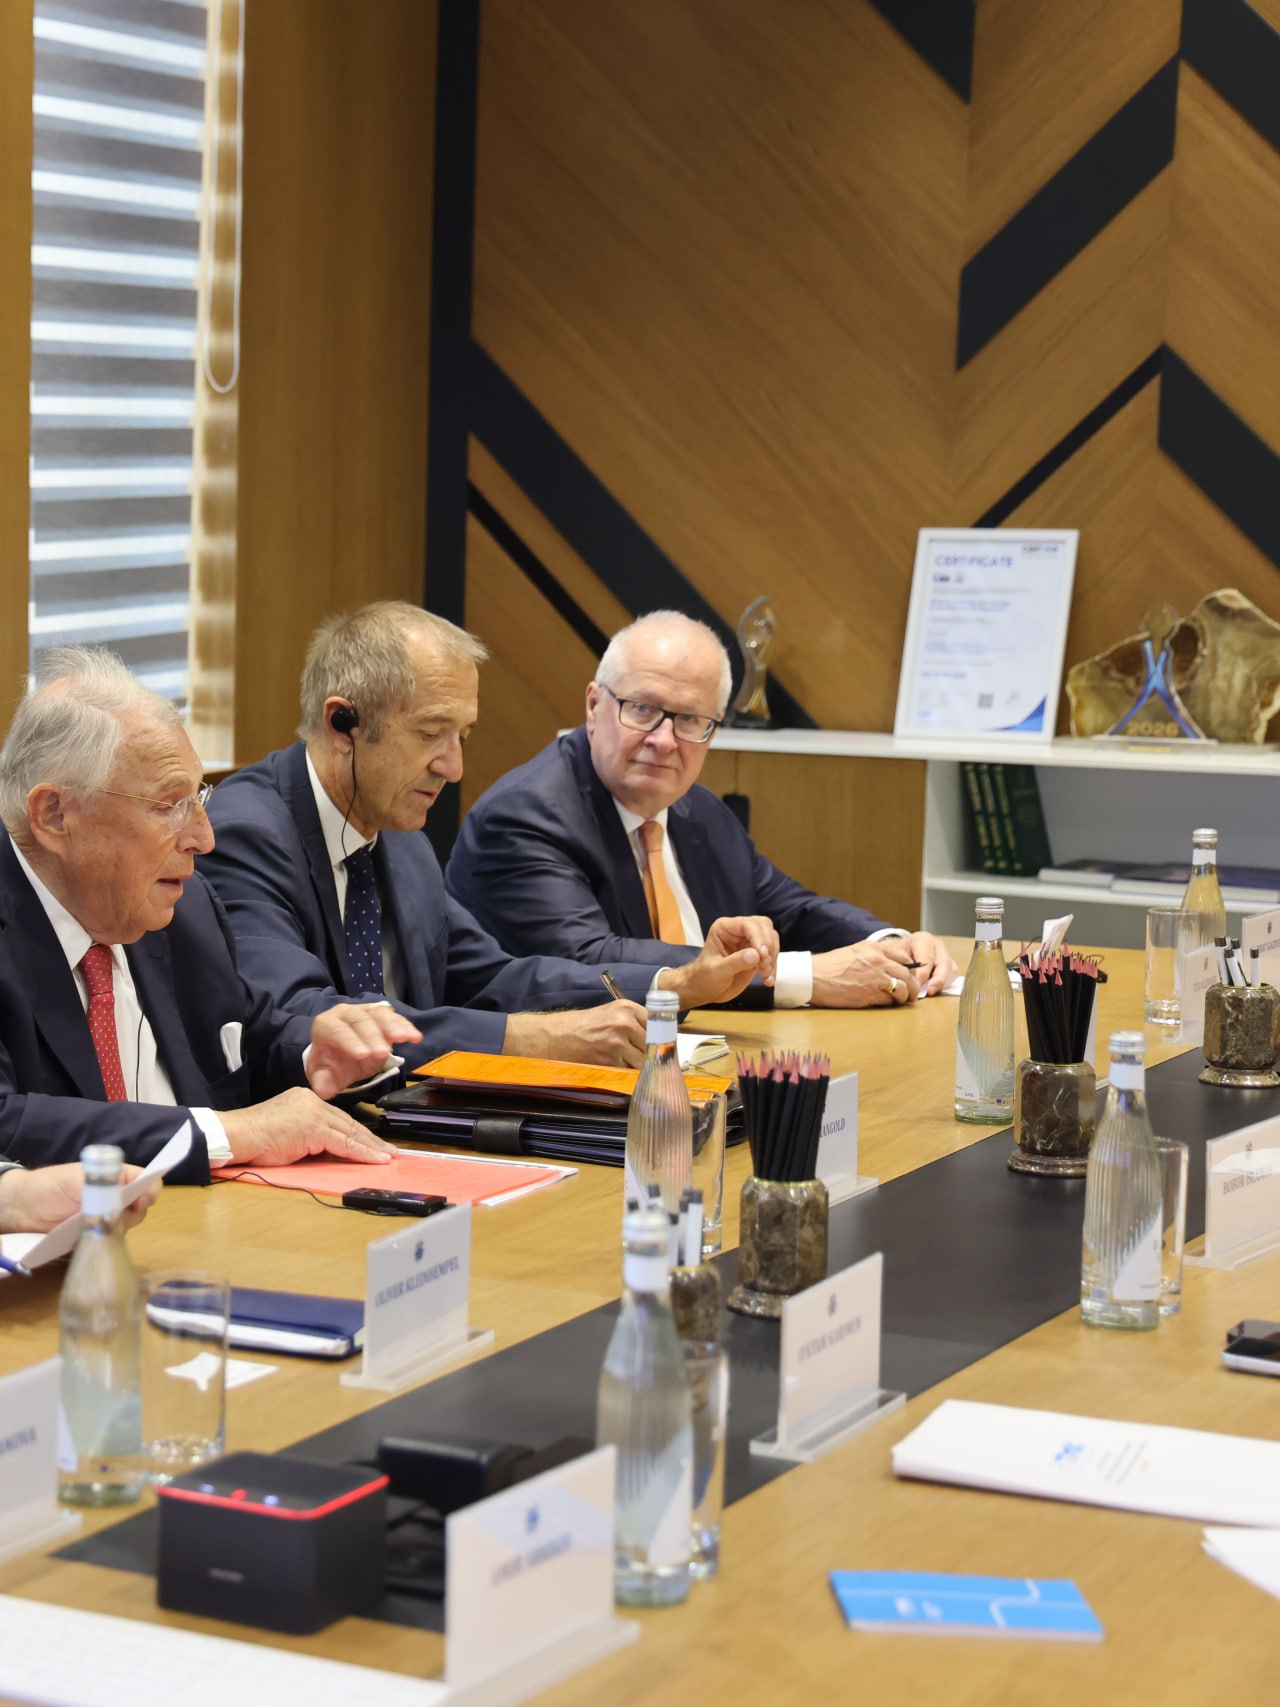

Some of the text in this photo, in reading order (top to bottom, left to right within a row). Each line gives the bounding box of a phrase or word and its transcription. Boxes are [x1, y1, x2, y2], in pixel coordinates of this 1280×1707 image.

[934, 554, 1013, 568] CERTIFICATE
[820, 1117, 846, 1138] ANGOLD
[374, 1281, 404, 1308] OLIVER
